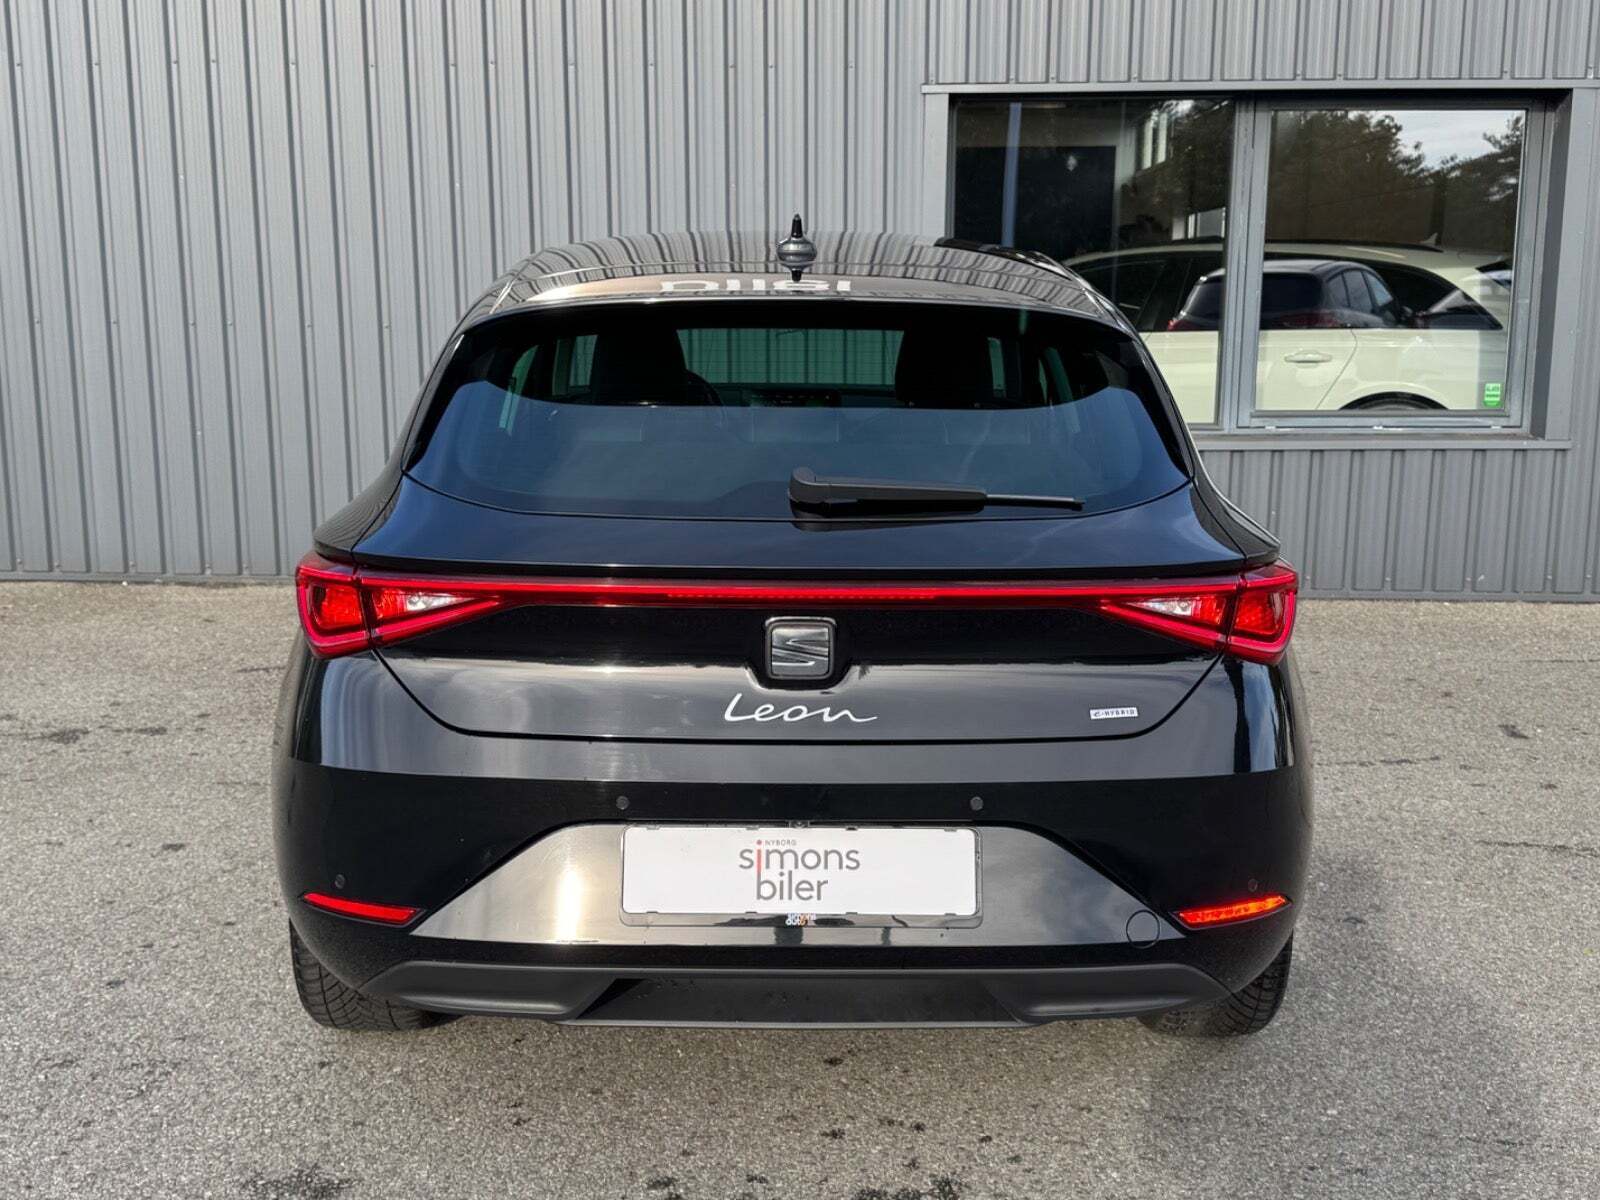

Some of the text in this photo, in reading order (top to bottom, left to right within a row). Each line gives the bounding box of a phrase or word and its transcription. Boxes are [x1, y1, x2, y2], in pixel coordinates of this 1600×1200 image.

[724, 693, 878, 722] Leon
[738, 839, 861, 870] simons
[756, 869, 829, 901] biler
